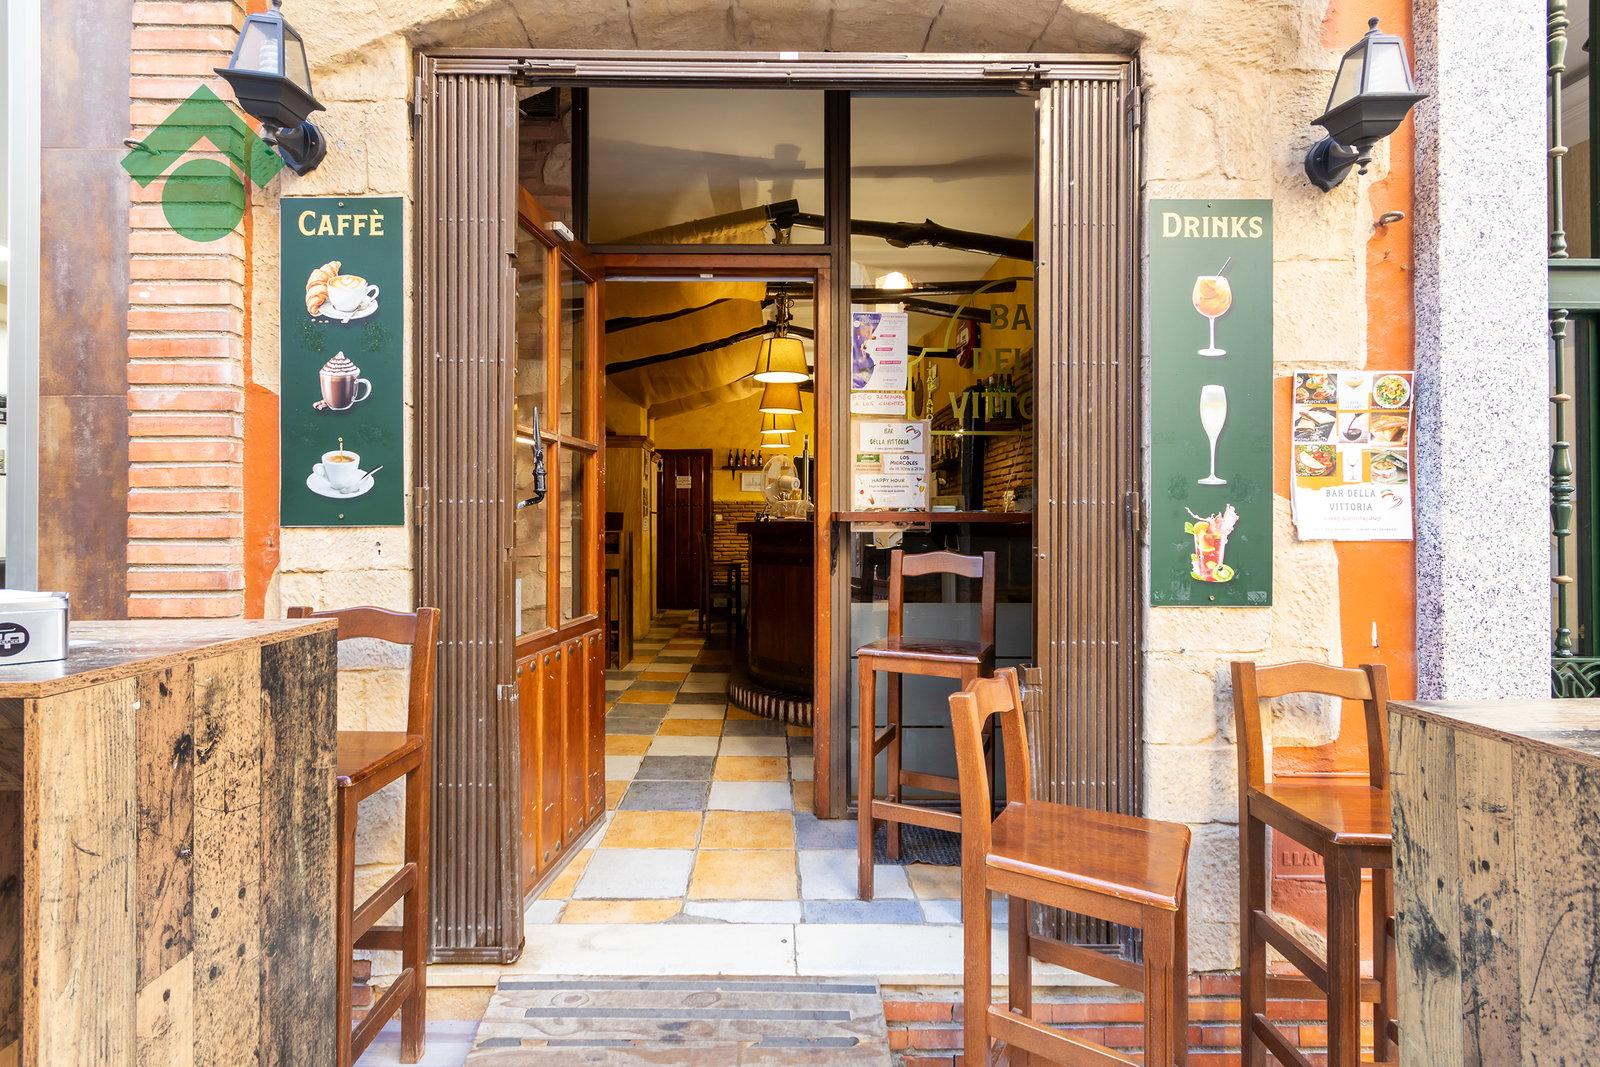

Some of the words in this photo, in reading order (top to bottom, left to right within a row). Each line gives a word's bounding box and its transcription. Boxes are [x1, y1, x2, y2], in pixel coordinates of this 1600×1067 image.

[298, 209, 384, 236] CAFFÈ
[1347, 490, 1376, 498] DELLA
[1329, 503, 1373, 511] VITTORIA
